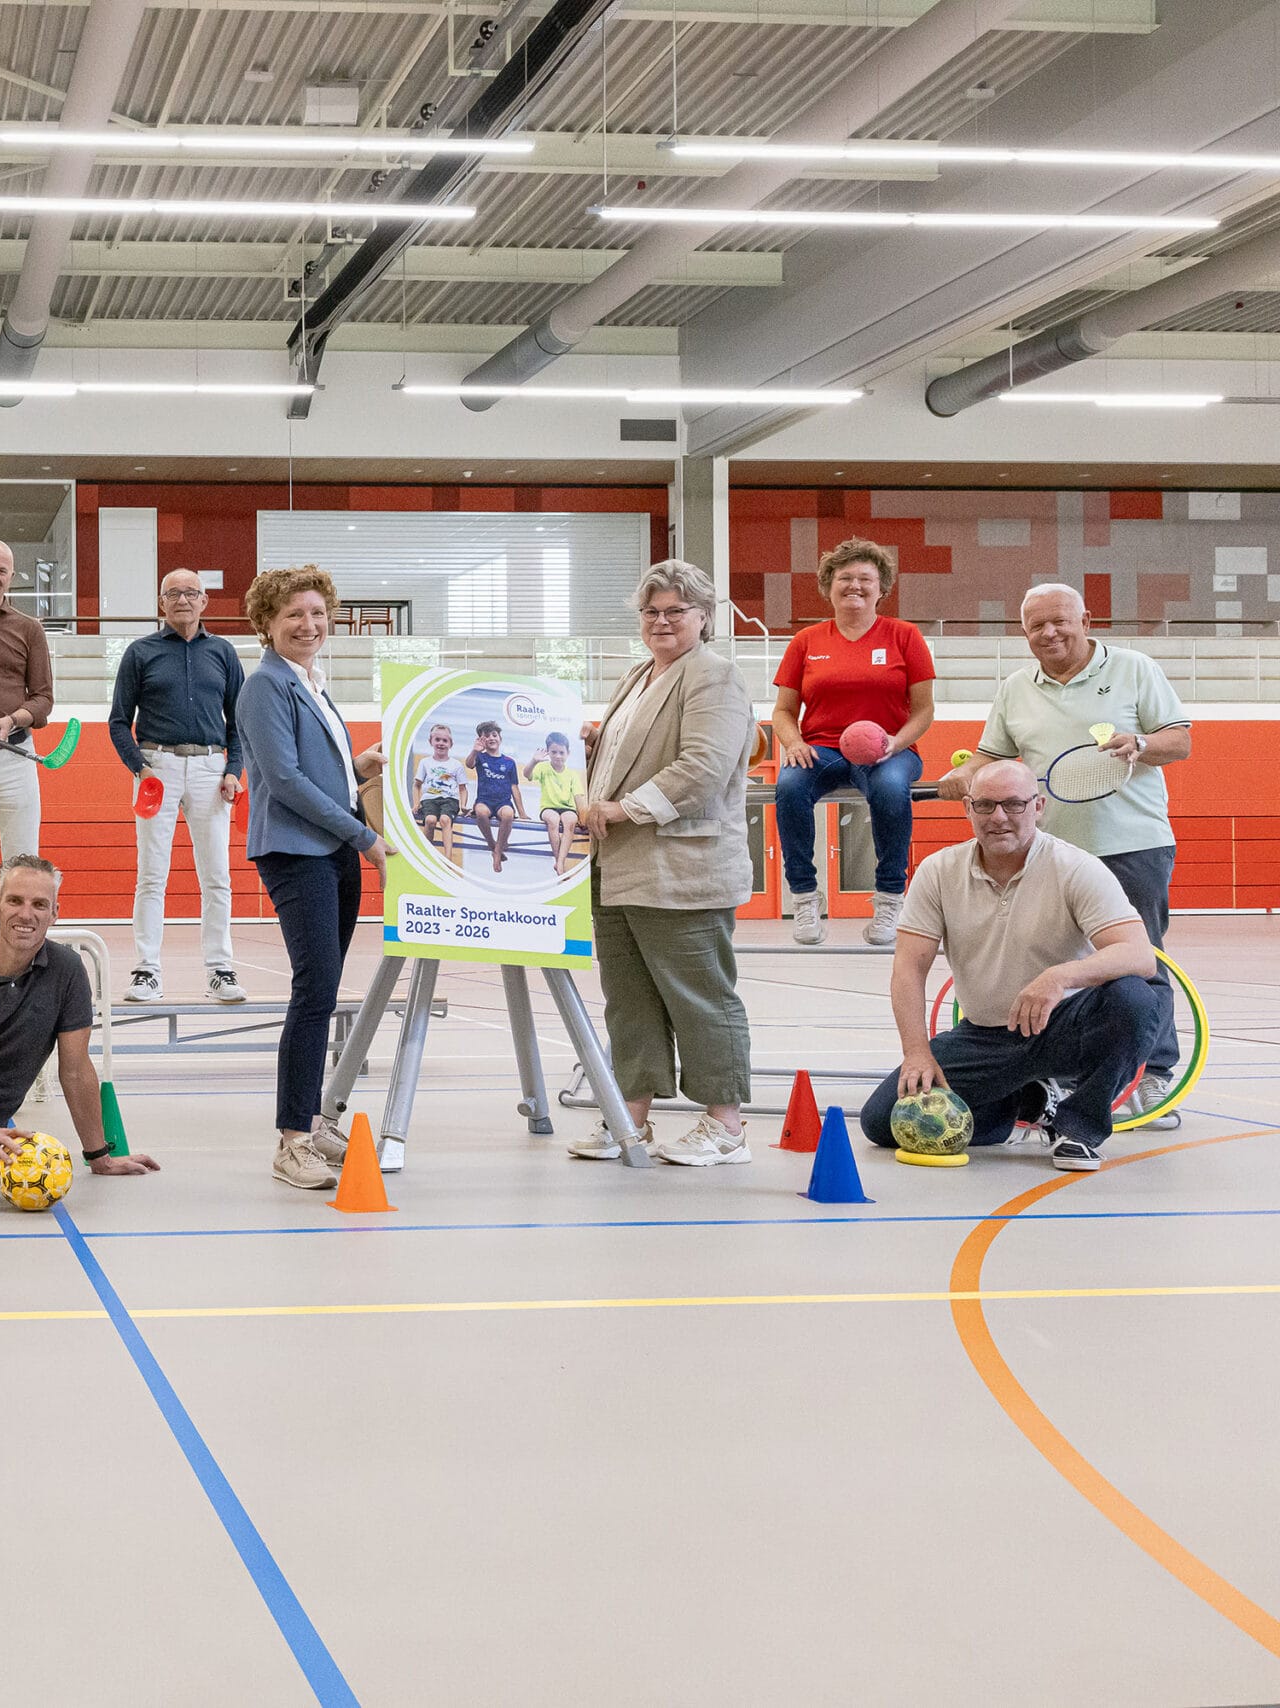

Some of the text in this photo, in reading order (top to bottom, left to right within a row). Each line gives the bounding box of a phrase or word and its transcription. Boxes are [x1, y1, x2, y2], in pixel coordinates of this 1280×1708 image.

[516, 704, 545, 715] Raalte
[405, 902, 557, 926] Raalter Sportakkoord
[405, 920, 441, 935] 2023
[455, 924, 490, 939] 2026
